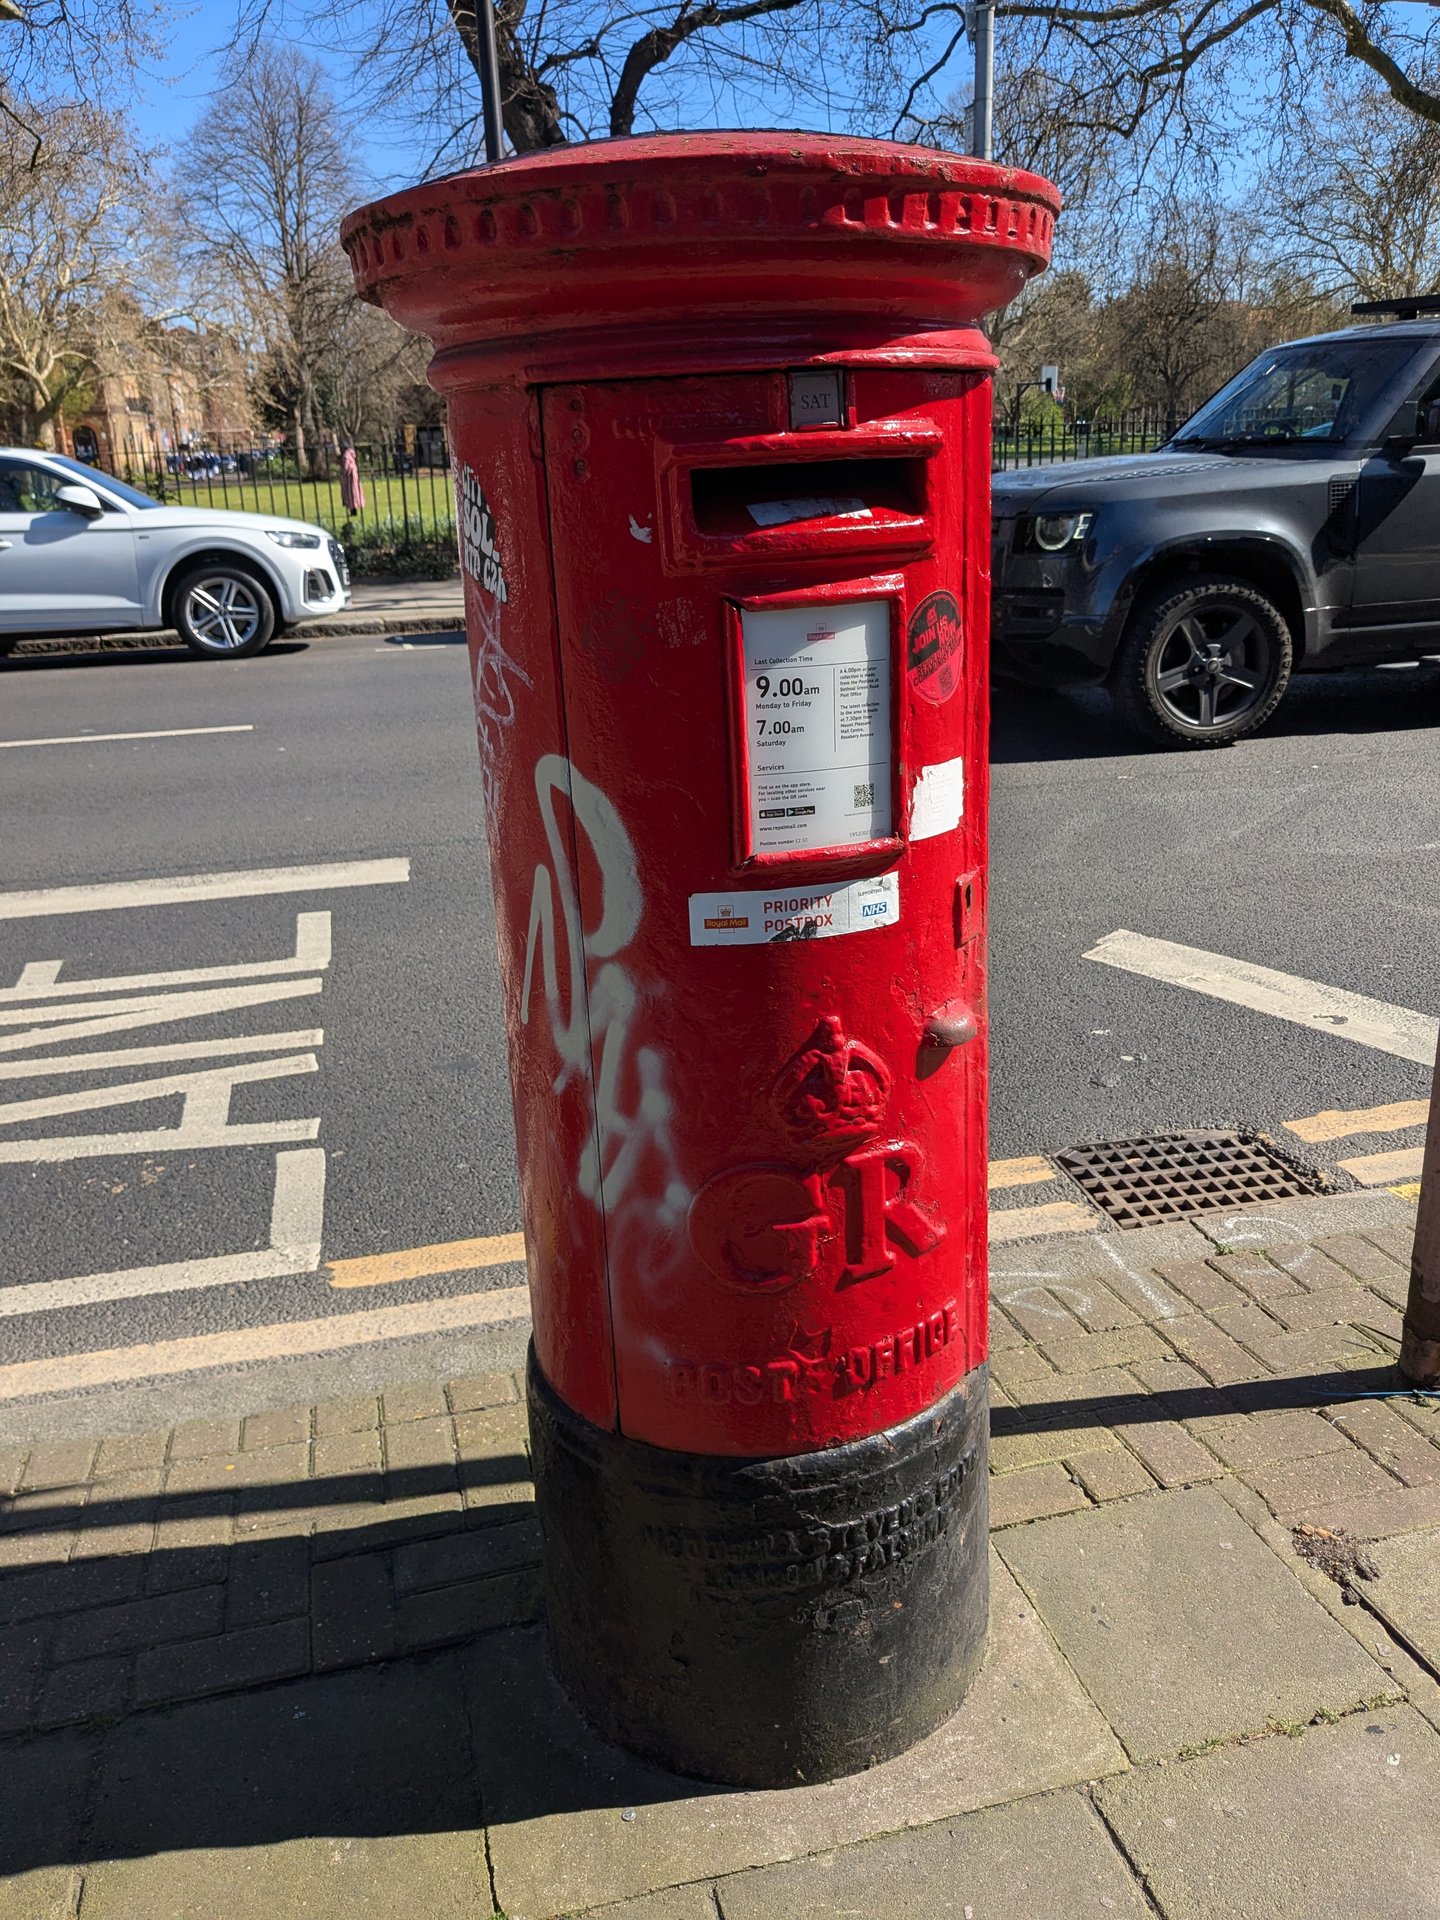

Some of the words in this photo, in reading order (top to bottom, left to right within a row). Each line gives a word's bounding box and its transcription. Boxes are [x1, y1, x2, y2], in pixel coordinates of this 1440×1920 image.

[801, 393, 830, 410] SAT
[912, 626, 936, 654] JOIN
[940, 618, 956, 647] NOW
[769, 656, 798, 664] Collection
[914, 650, 949, 687] COMMUNIST
[756, 676, 820, 698] 9.00am
[756, 702, 782, 710] Monday
[792, 700, 812, 708] Friday
[756, 720, 805, 736] 7.00am
[756, 740, 786, 748] Saturday
[758, 764, 784, 772] Services
[759, 824, 807, 832] www.royalmail.com
[858, 888, 882, 897] SUPPORTING
[764, 895, 832, 914] PRIORITY
[864, 902, 886, 916] NHS
[706, 920, 728, 929] Royal
[729, 918, 747, 926] Mail
[688, 1138, 947, 1294] GR
[846, 1298, 959, 1386] OFFICE
